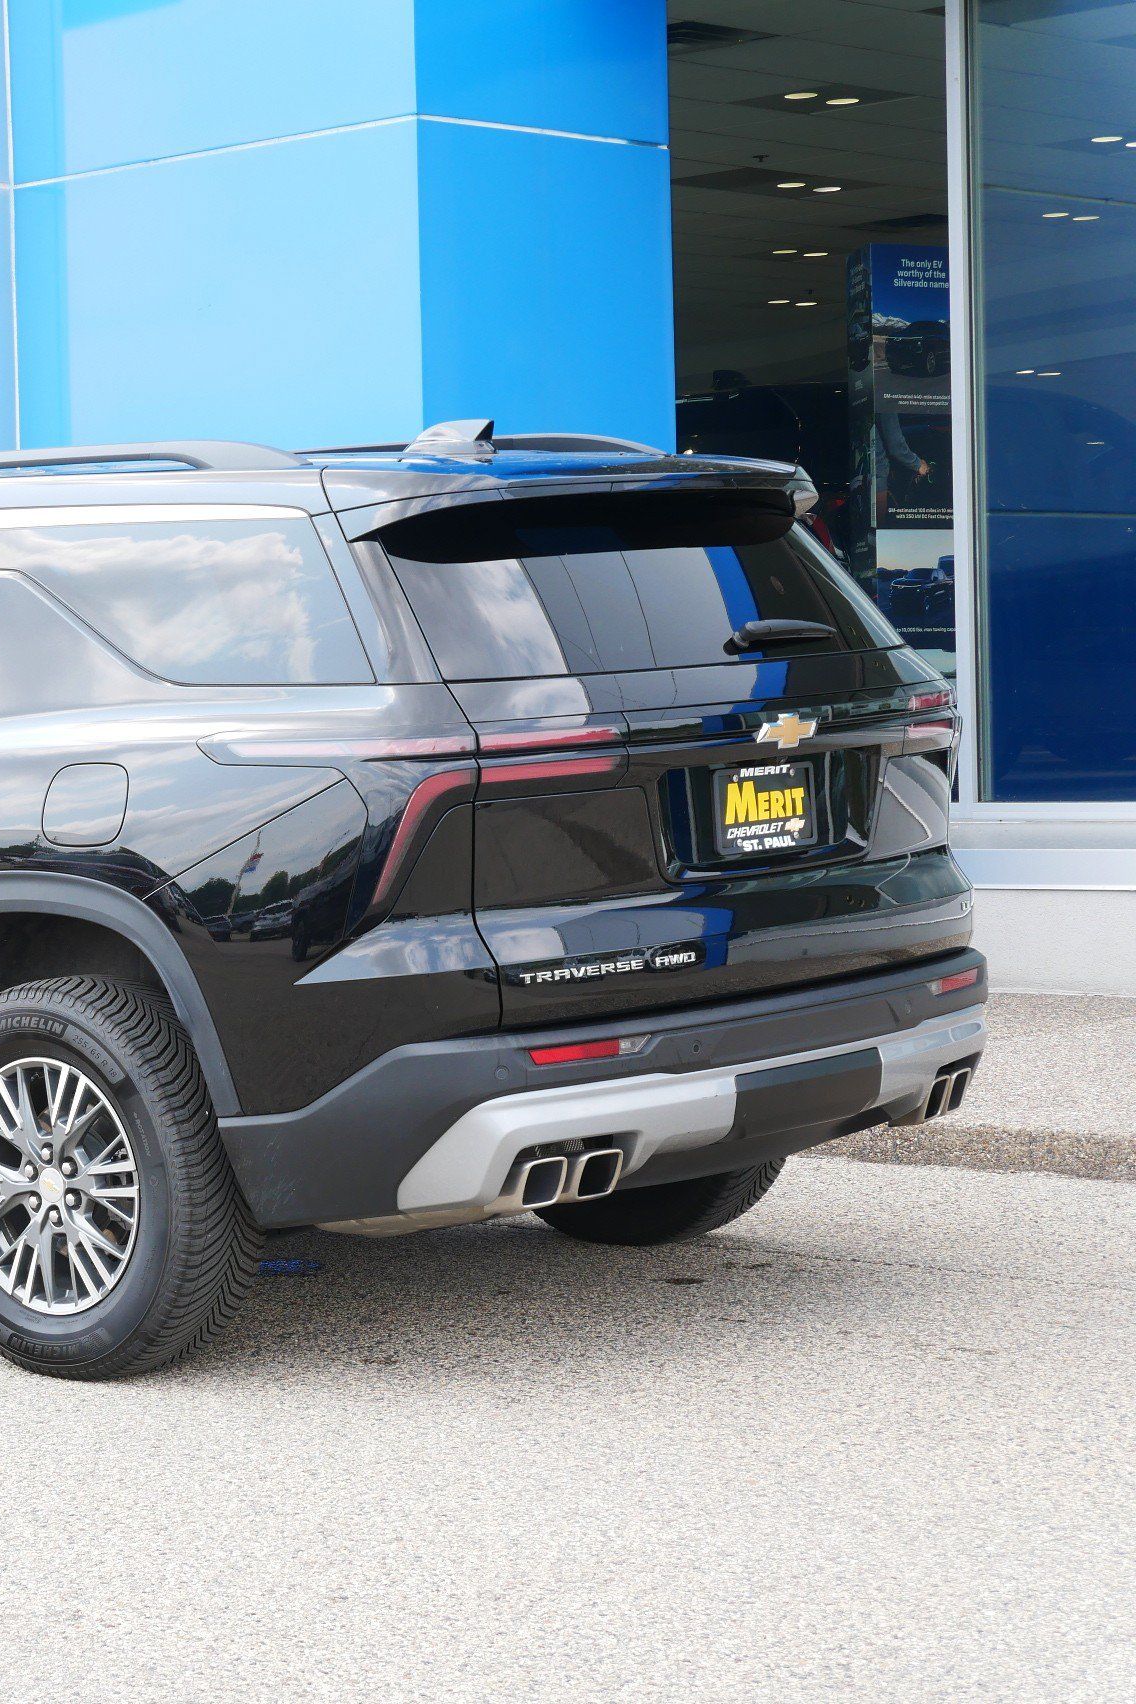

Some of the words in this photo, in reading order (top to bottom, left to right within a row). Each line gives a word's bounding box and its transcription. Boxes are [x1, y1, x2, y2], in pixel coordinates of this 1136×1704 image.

[901, 259, 915, 268] The
[916, 260, 932, 269] only
[932, 260, 943, 269] EV
[897, 270, 924, 279] worthy
[924, 270, 933, 278] of
[933, 270, 946, 279] the
[893, 278, 928, 288] Silverado
[740, 764, 791, 778] MERIT
[727, 822, 783, 839] CHEVROLET
[742, 838, 762, 852] ST.
[764, 835, 795, 849] PAUL
[519, 959, 644, 985] TRAVERSE
[655, 951, 696, 968] AWD
